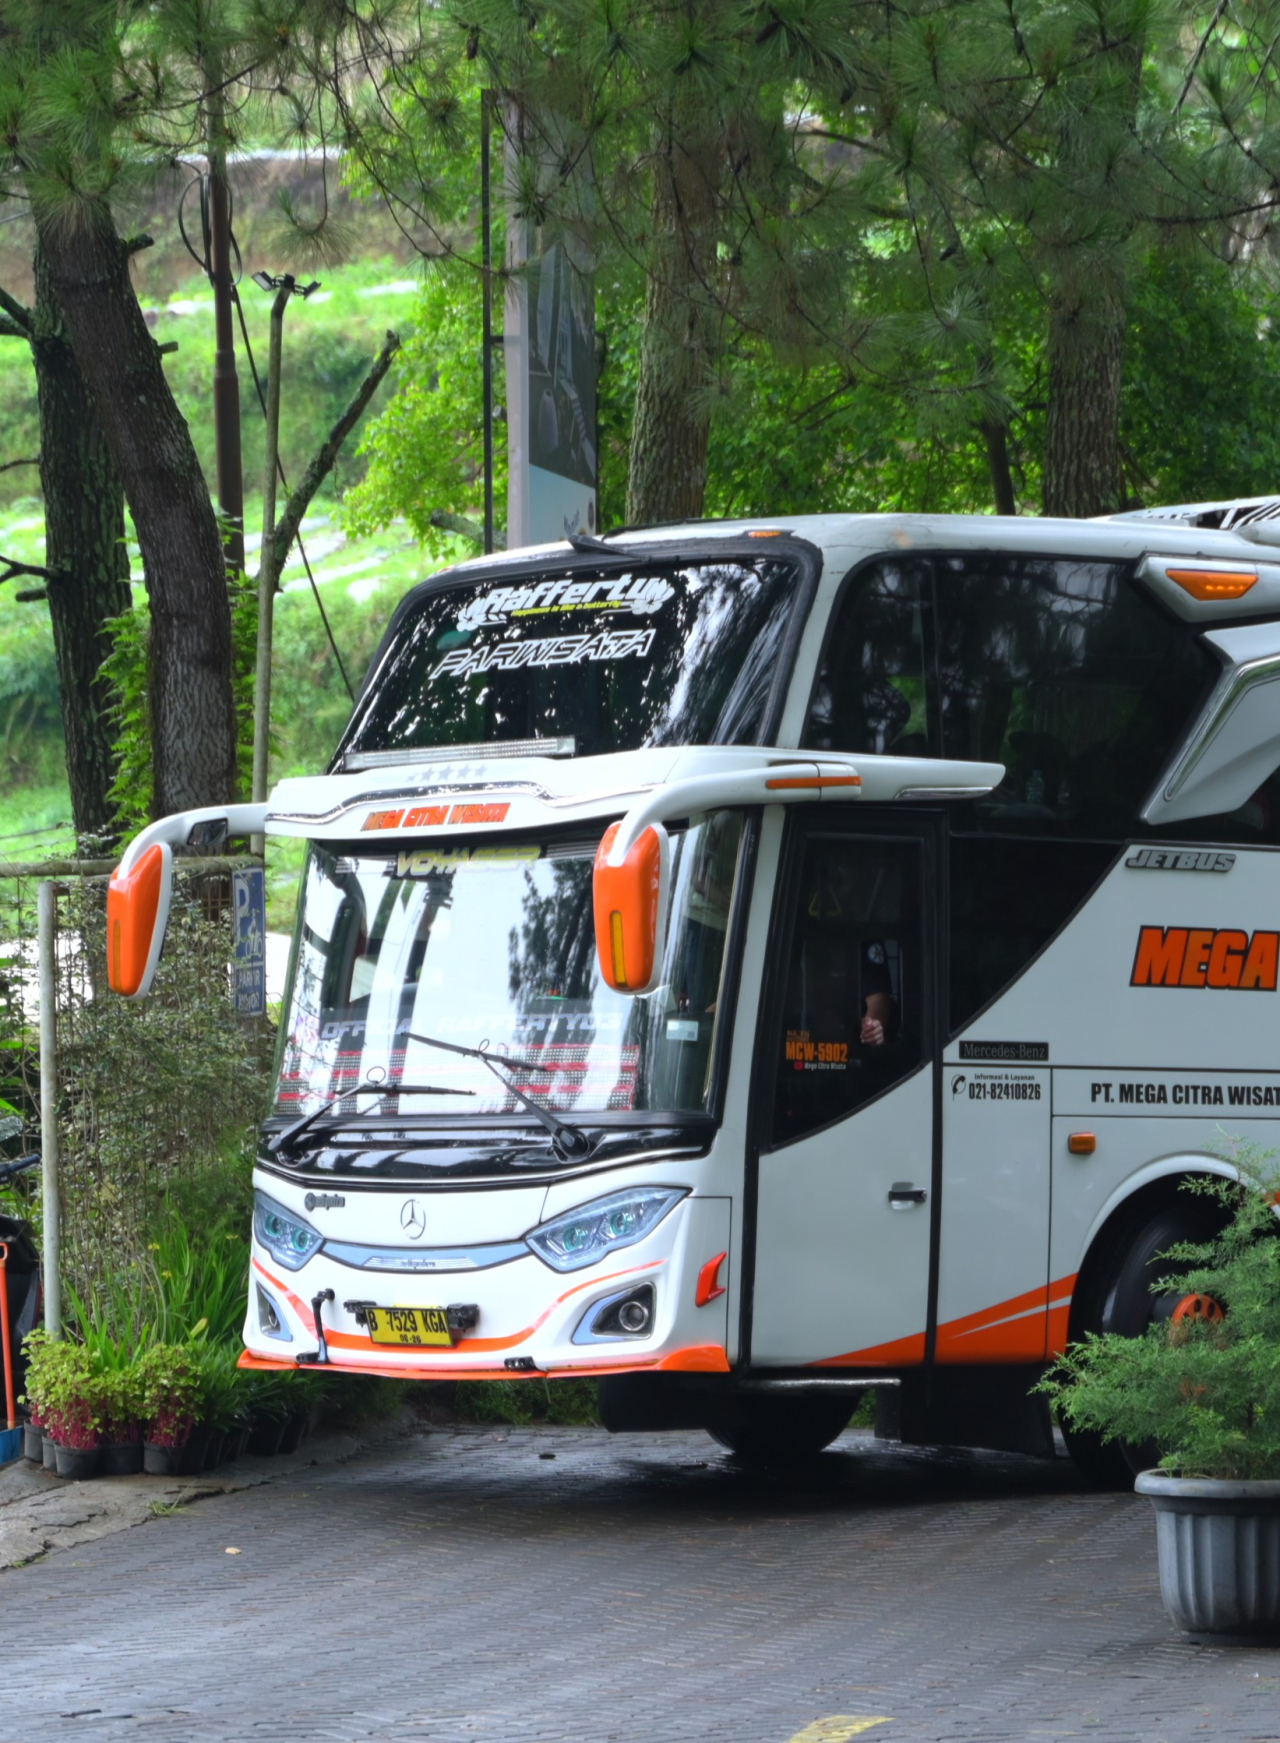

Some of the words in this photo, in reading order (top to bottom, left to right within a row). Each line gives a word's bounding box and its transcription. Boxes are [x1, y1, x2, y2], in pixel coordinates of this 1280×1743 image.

[429, 628, 656, 679] PARIWISATA
[360, 809, 405, 831] MEGA
[402, 805, 450, 827] CITRA
[448, 803, 511, 825] WISATA
[1126, 850, 1236, 872] JETBUS
[1129, 925, 1280, 991] MEGA
[239, 970, 260, 988] PARIR
[786, 1041, 848, 1062] MCW-5902
[964, 1043, 1045, 1058] Mercedes-Benz
[1010, 1074, 1035, 1082] Layanan
[969, 1082, 1041, 1100] 021-82410826
[1091, 1083, 1115, 1103] PT.
[1119, 1083, 1168, 1104] MEGA
[1172, 1085, 1224, 1105] CITRA
[368, 1311, 378, 1331] B
[386, 1310, 418, 1332] 7529
[421, 1310, 448, 1333] KGA
